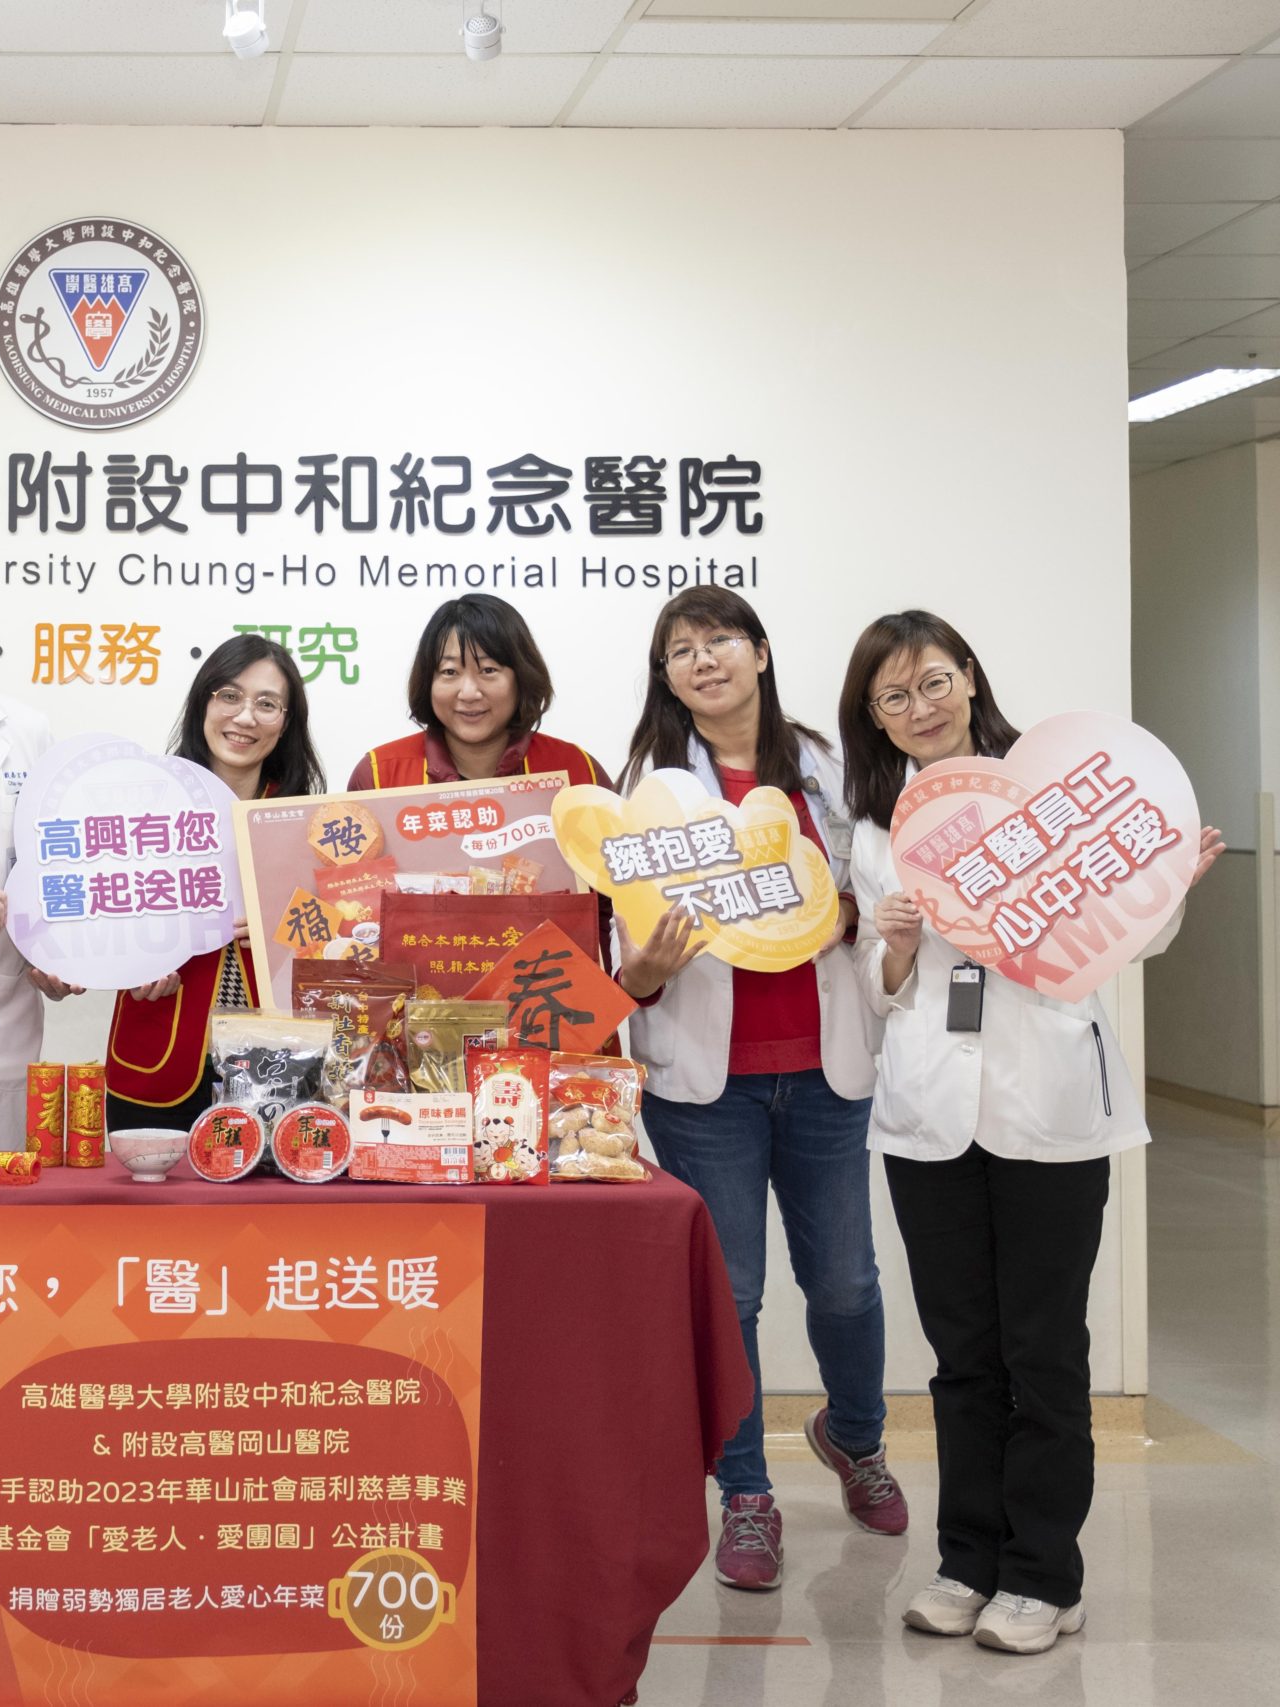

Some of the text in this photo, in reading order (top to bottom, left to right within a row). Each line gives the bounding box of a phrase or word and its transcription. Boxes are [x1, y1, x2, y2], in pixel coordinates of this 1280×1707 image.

[3, 332, 195, 419] KAOHSIUNG MEDICAL UNIVERSITY HOSPITAL
[86, 388, 114, 398] 1957
[118, 554, 337, 593] Chung-Ho
[359, 555, 557, 587] Memorial
[581, 556, 758, 593] Hospital
[32, 622, 162, 685] 服務
[38, 810, 218, 860] 高興有您
[318, 816, 367, 858] 平安
[402, 806, 498, 834] 年菜認助
[471, 822, 550, 851] 每份700元
[945, 755, 1130, 906] 高醫員工
[604, 819, 740, 881] 擁抱愛
[42, 866, 224, 918] 醫起送暖
[665, 866, 801, 927] 不孤單
[992, 802, 1177, 954] 心中有愛
[287, 899, 332, 947] 福
[507, 949, 595, 1051] 春
[20, 1377, 421, 1410] 高雄醫學大學附設中和紀念醫院
[93, 1428, 350, 1458] & 附設高醫岡山醫院
[9, 1584, 325, 1613] 捐贈弱勢獨居老人愛心年菜
[347, 1570, 439, 1611] 700
[379, 1614, 404, 1640] 份
